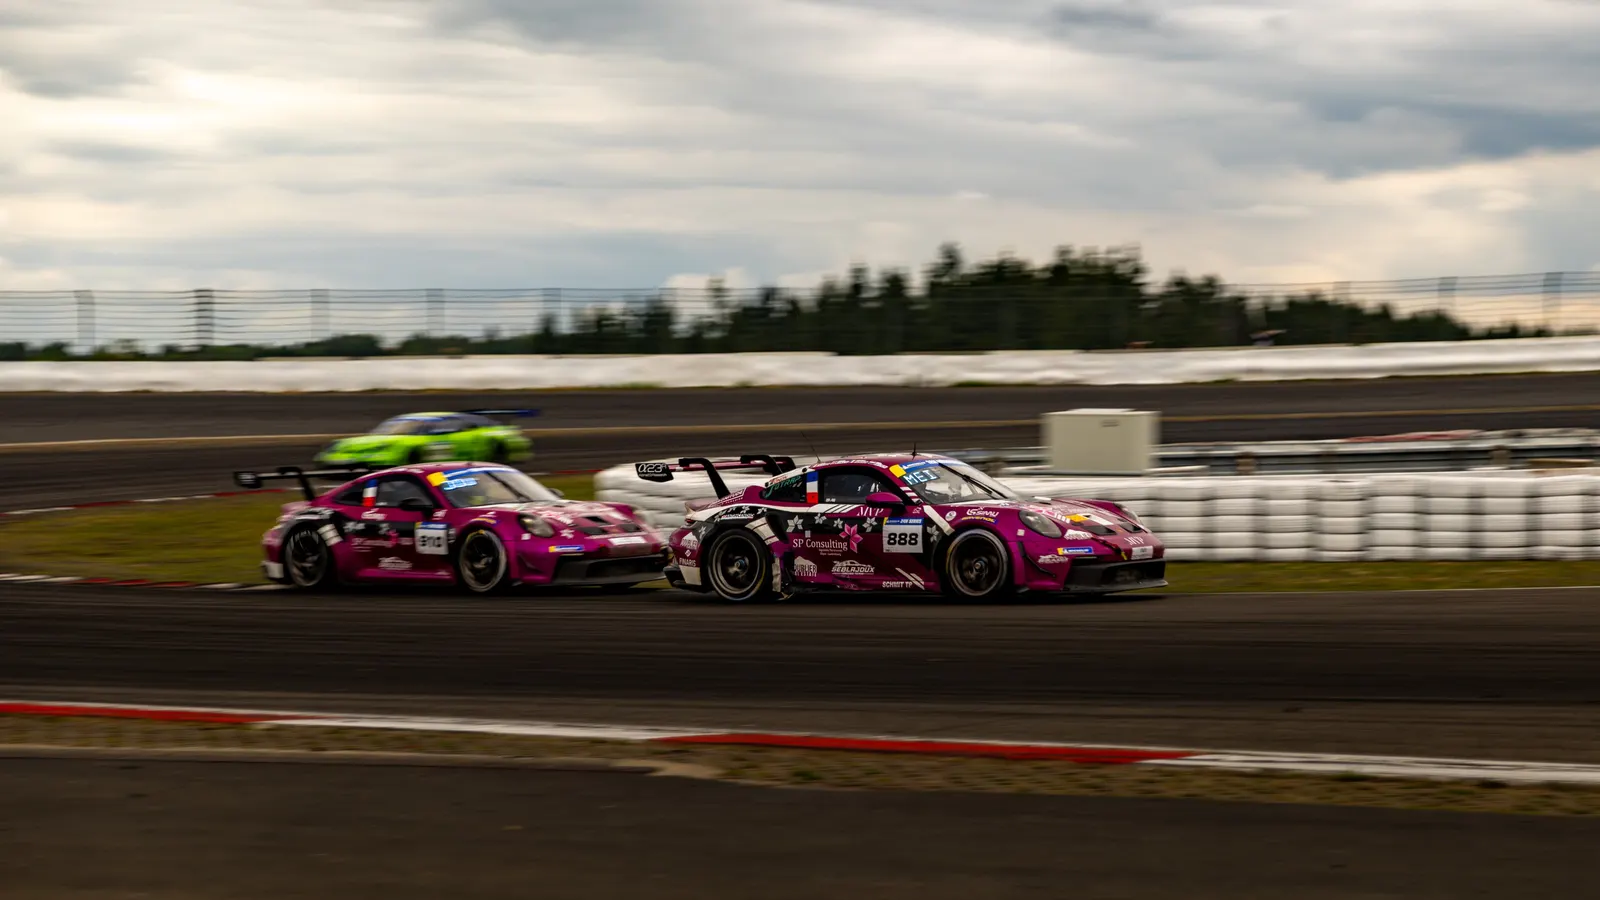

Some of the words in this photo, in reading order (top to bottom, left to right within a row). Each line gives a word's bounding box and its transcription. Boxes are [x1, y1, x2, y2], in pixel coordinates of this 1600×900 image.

[904, 469, 938, 486] MEI
[857, 507, 884, 516] MVP
[793, 539, 804, 548] SP
[806, 539, 848, 552] Consulting
[887, 533, 919, 546] 888
[679, 557, 697, 568] FINARIS
